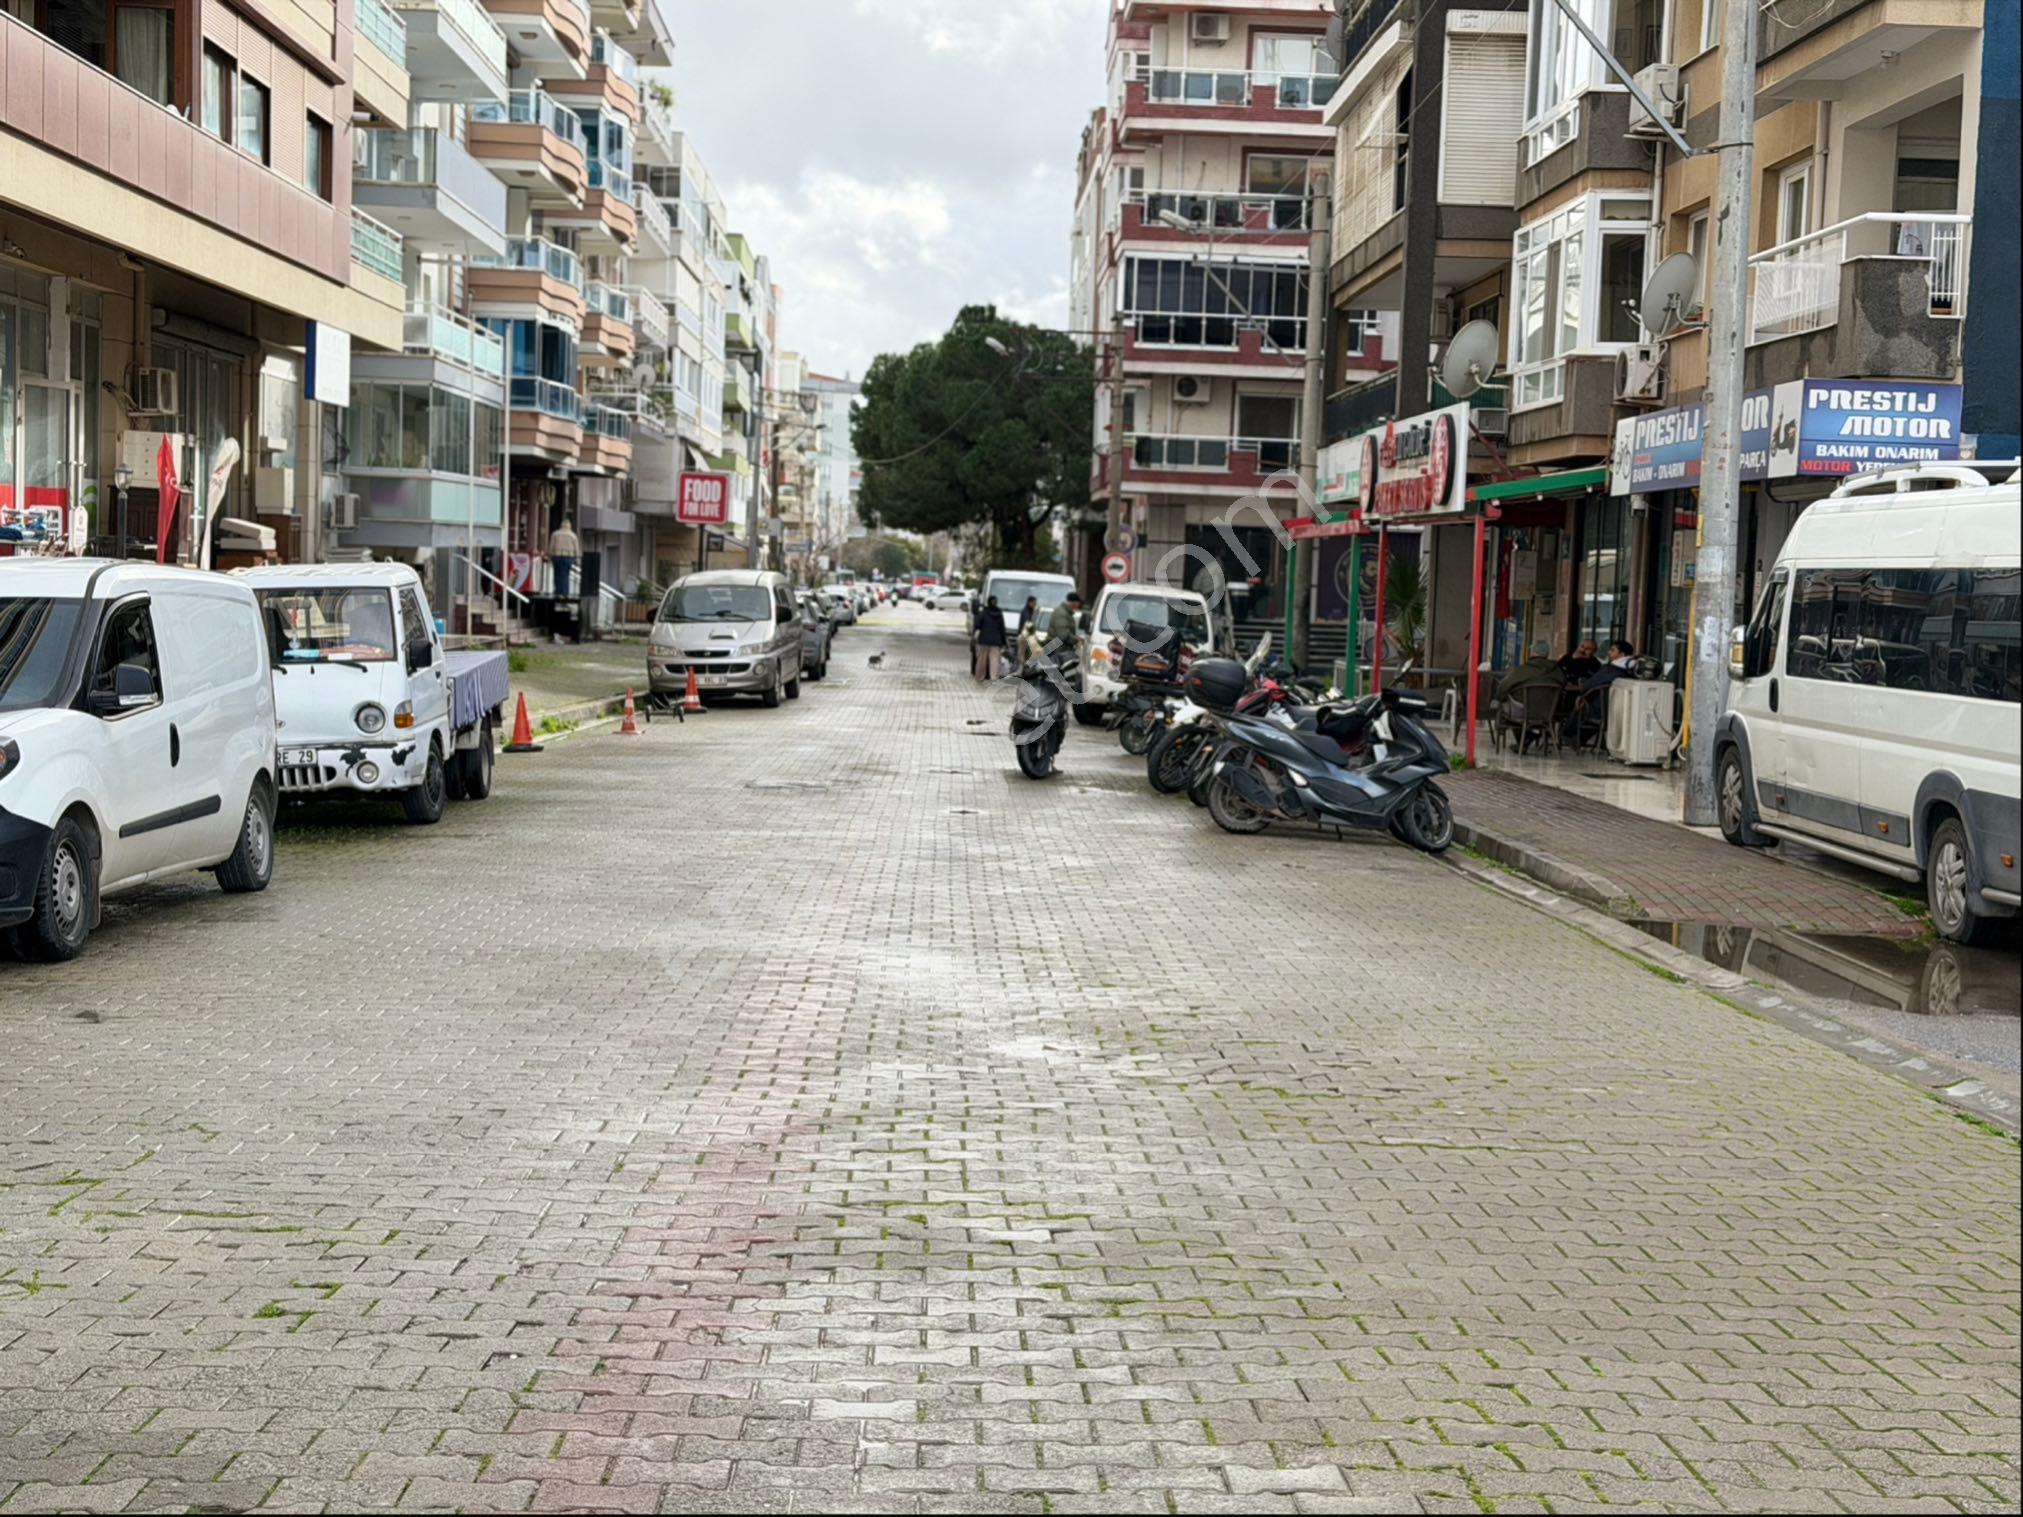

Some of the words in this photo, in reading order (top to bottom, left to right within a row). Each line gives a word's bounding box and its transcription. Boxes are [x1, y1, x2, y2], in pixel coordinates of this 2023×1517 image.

[1808, 388, 1937, 413] PRESTIJ
[1839, 415, 1952, 439] MOTOR
[1739, 450, 1766, 473] PARÇA
[1816, 444, 1868, 458] BAKIM
[1875, 447, 1939, 460] ONARIM
[1800, 459, 1851, 473] MOTOR
[684, 478, 722, 502] FOOD
[683, 502, 699, 516] FOR
[700, 502, 720, 518] LOVE
[298, 750, 313, 763] 29
